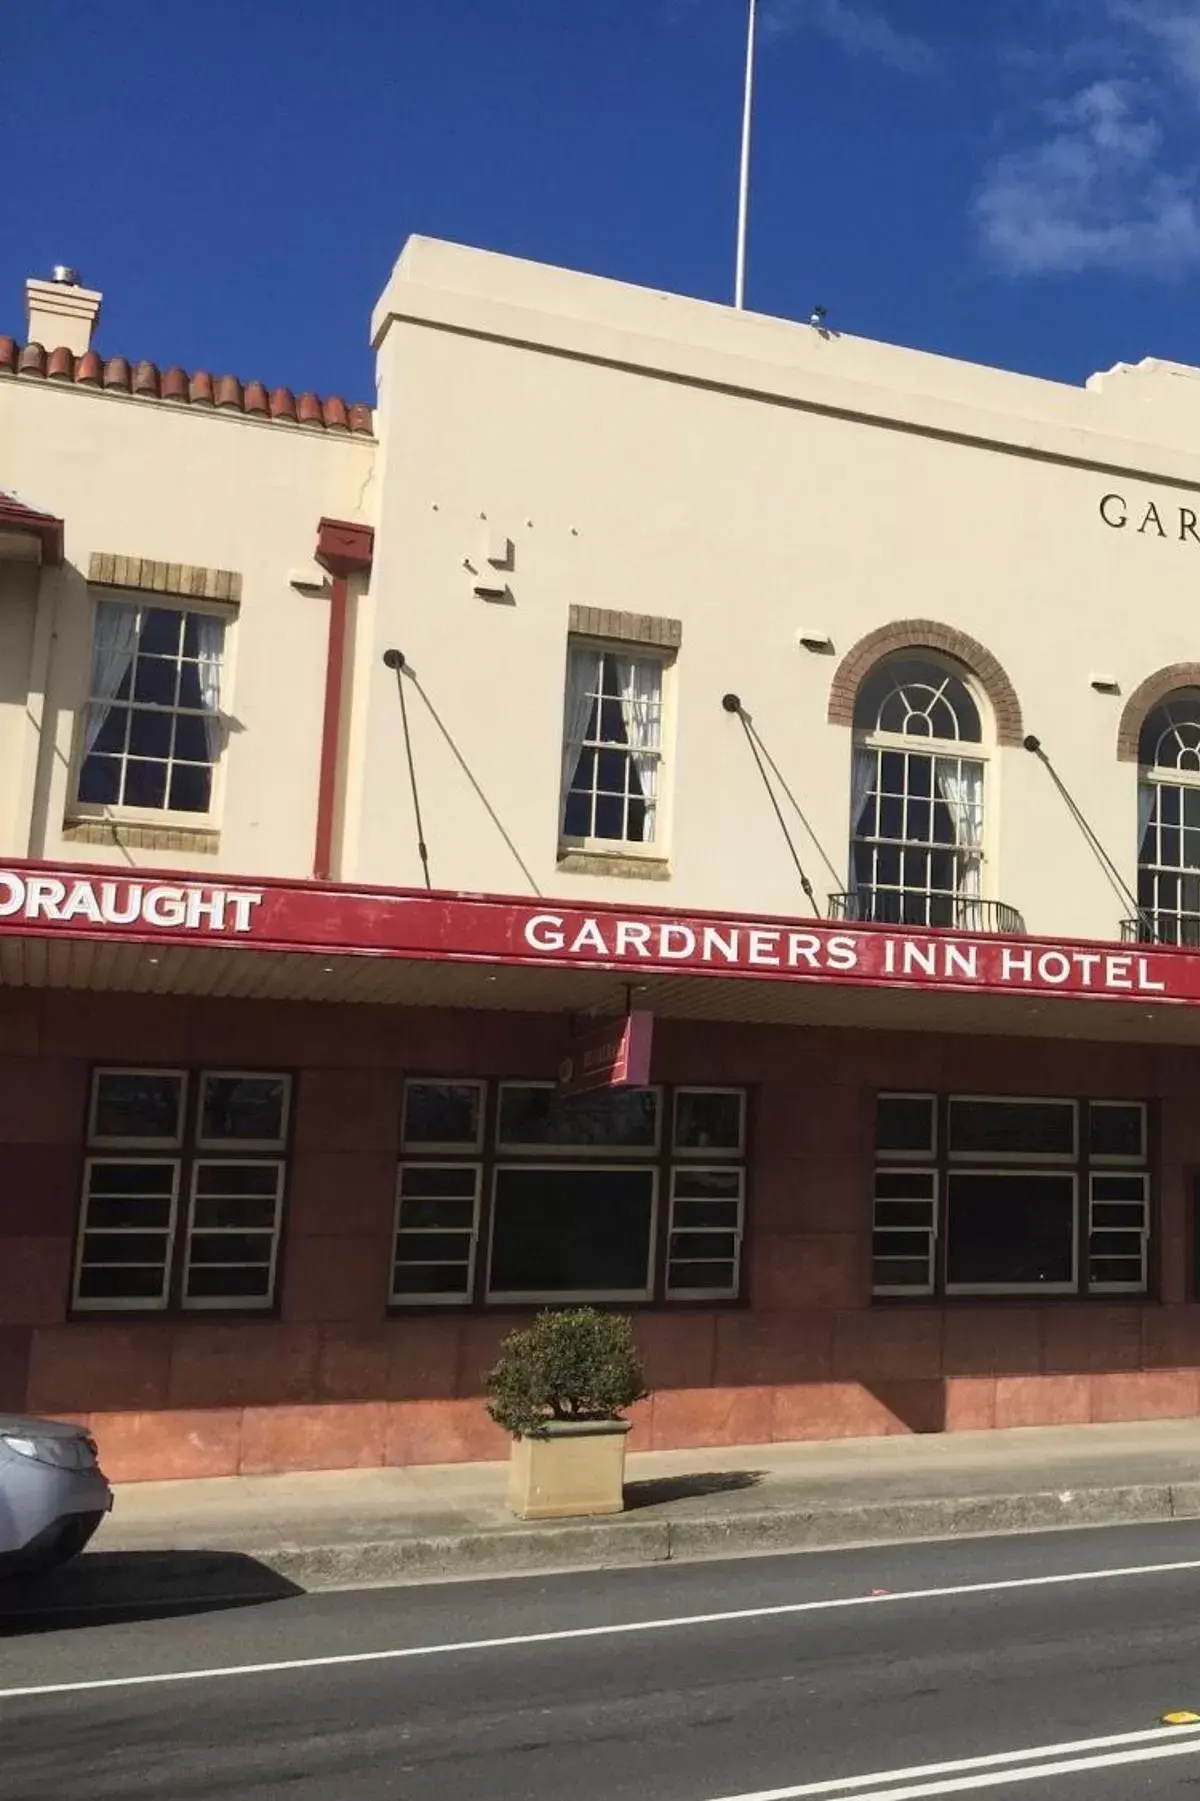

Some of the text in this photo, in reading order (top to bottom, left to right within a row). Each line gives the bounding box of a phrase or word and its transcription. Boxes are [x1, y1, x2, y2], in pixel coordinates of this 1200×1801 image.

[0, 870, 263, 933] DRAUGHT
[524, 914, 1165, 991] GARDNERS INN HOTEL
